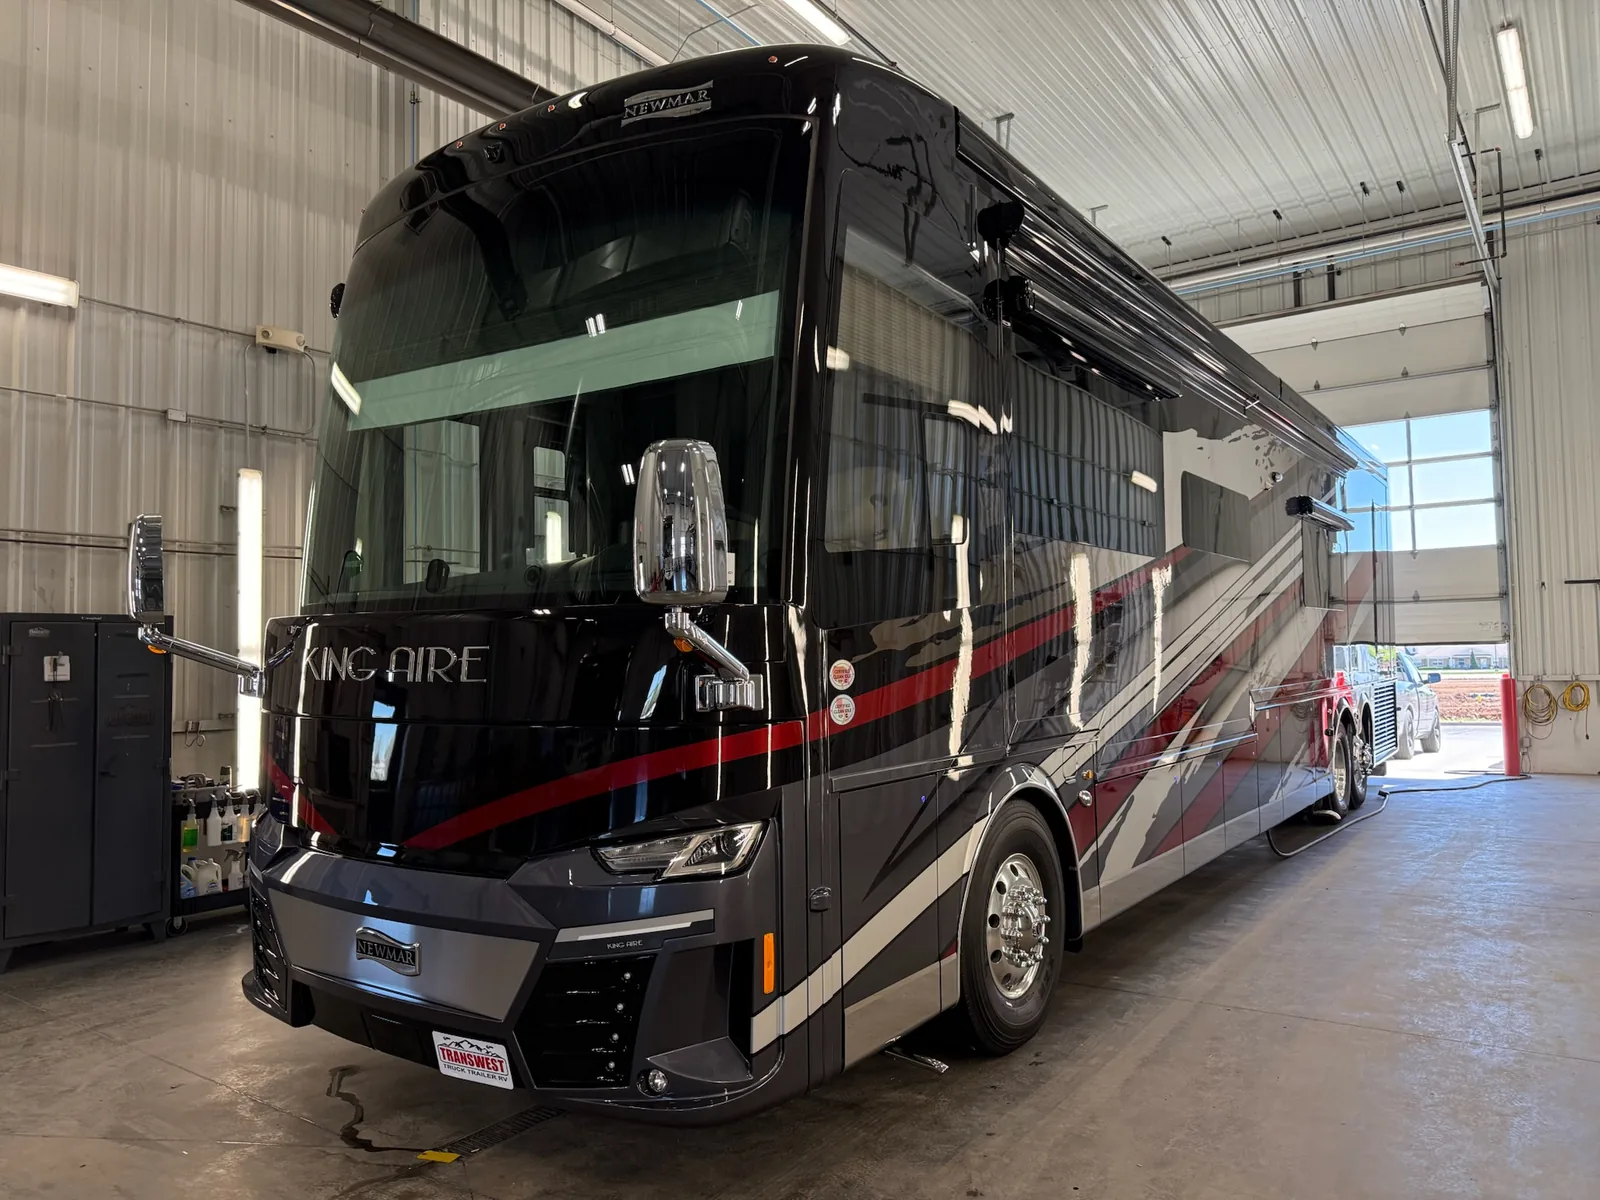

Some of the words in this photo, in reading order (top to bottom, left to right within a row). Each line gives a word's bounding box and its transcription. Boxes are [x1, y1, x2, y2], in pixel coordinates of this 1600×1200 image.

[623, 89, 711, 118] NEWMAR
[303, 646, 378, 681] KING
[386, 645, 490, 682] AIRE
[357, 941, 414, 964] NEWMAR
[440, 1047, 504, 1073] TRANSWEST
[444, 1064, 466, 1074] TRUCK
[468, 1070, 497, 1081] TRAILER
